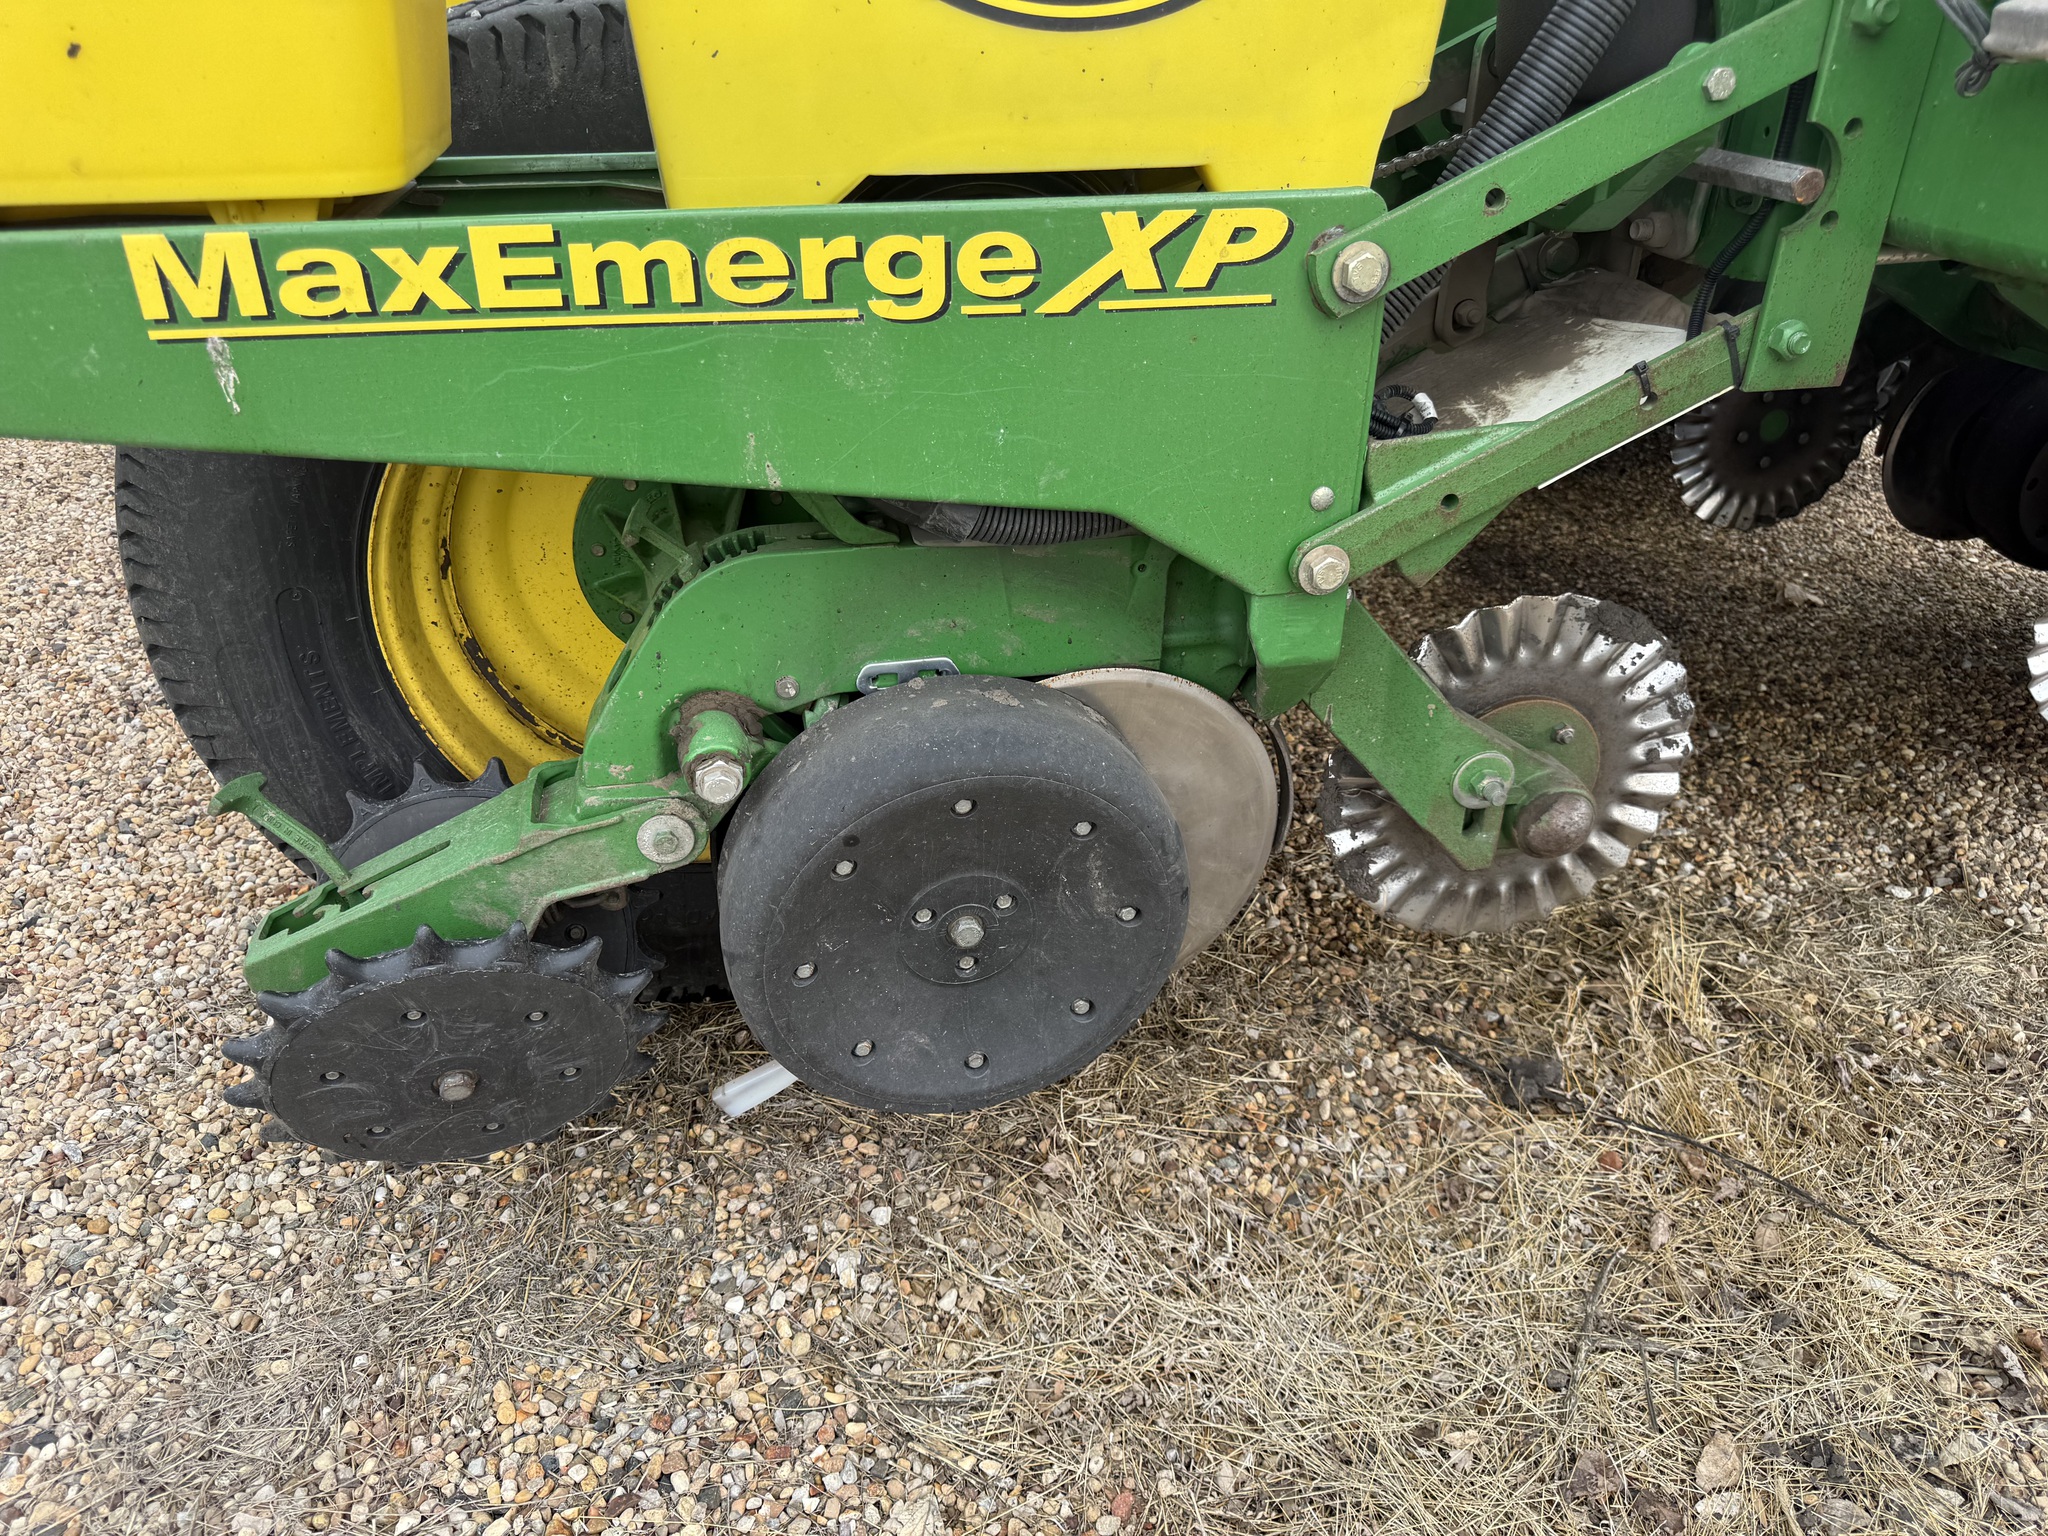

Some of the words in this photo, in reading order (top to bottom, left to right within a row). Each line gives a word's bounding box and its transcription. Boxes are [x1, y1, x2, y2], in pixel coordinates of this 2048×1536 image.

[121, 223, 1041, 322] MaxEmerge
[1034, 207, 1295, 317] XP
[299, 650, 396, 795] IMPLEMENTS
